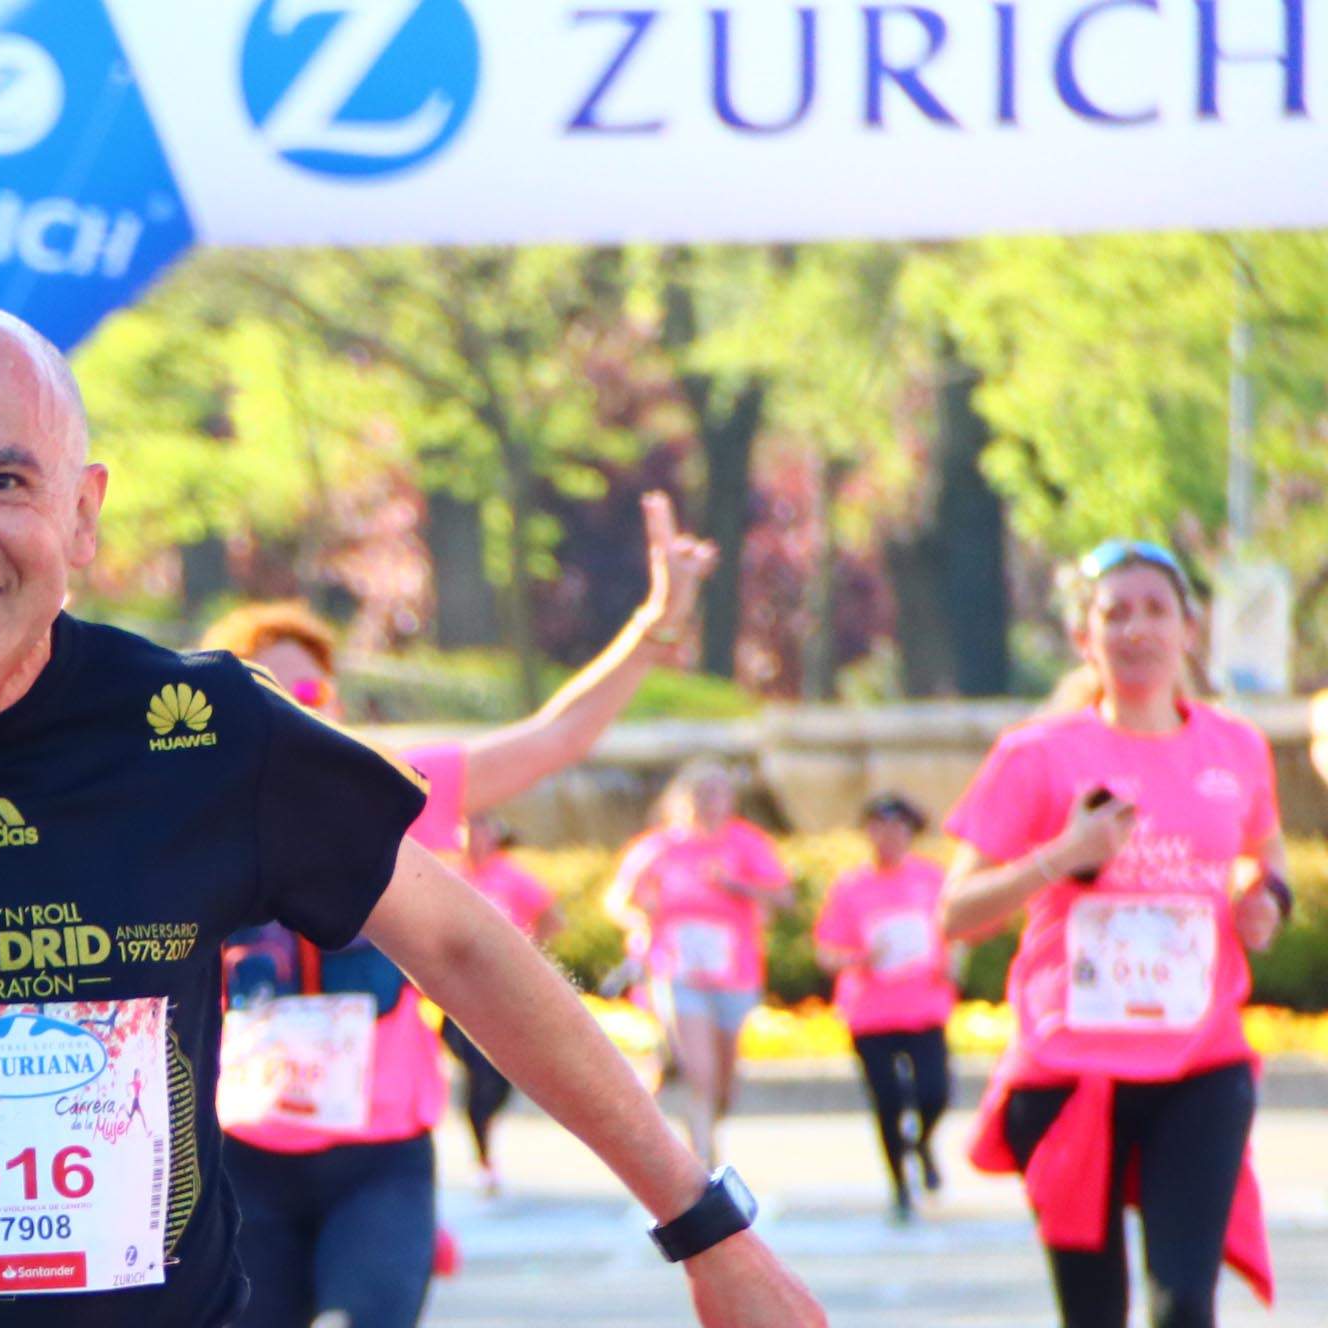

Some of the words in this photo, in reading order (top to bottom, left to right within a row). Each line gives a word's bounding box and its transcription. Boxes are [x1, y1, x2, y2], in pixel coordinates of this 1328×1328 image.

[562, 0, 1312, 136] ZURICH
[149, 732, 217, 751] HUAWEI
[115, 922, 199, 940] ANIVERSARIO
[117, 938, 196, 963] 1978-2017
[55, 1095, 116, 1117] Carrera
[18, 1265, 75, 1278] Santander
[112, 1271, 146, 1287] ZURICH
